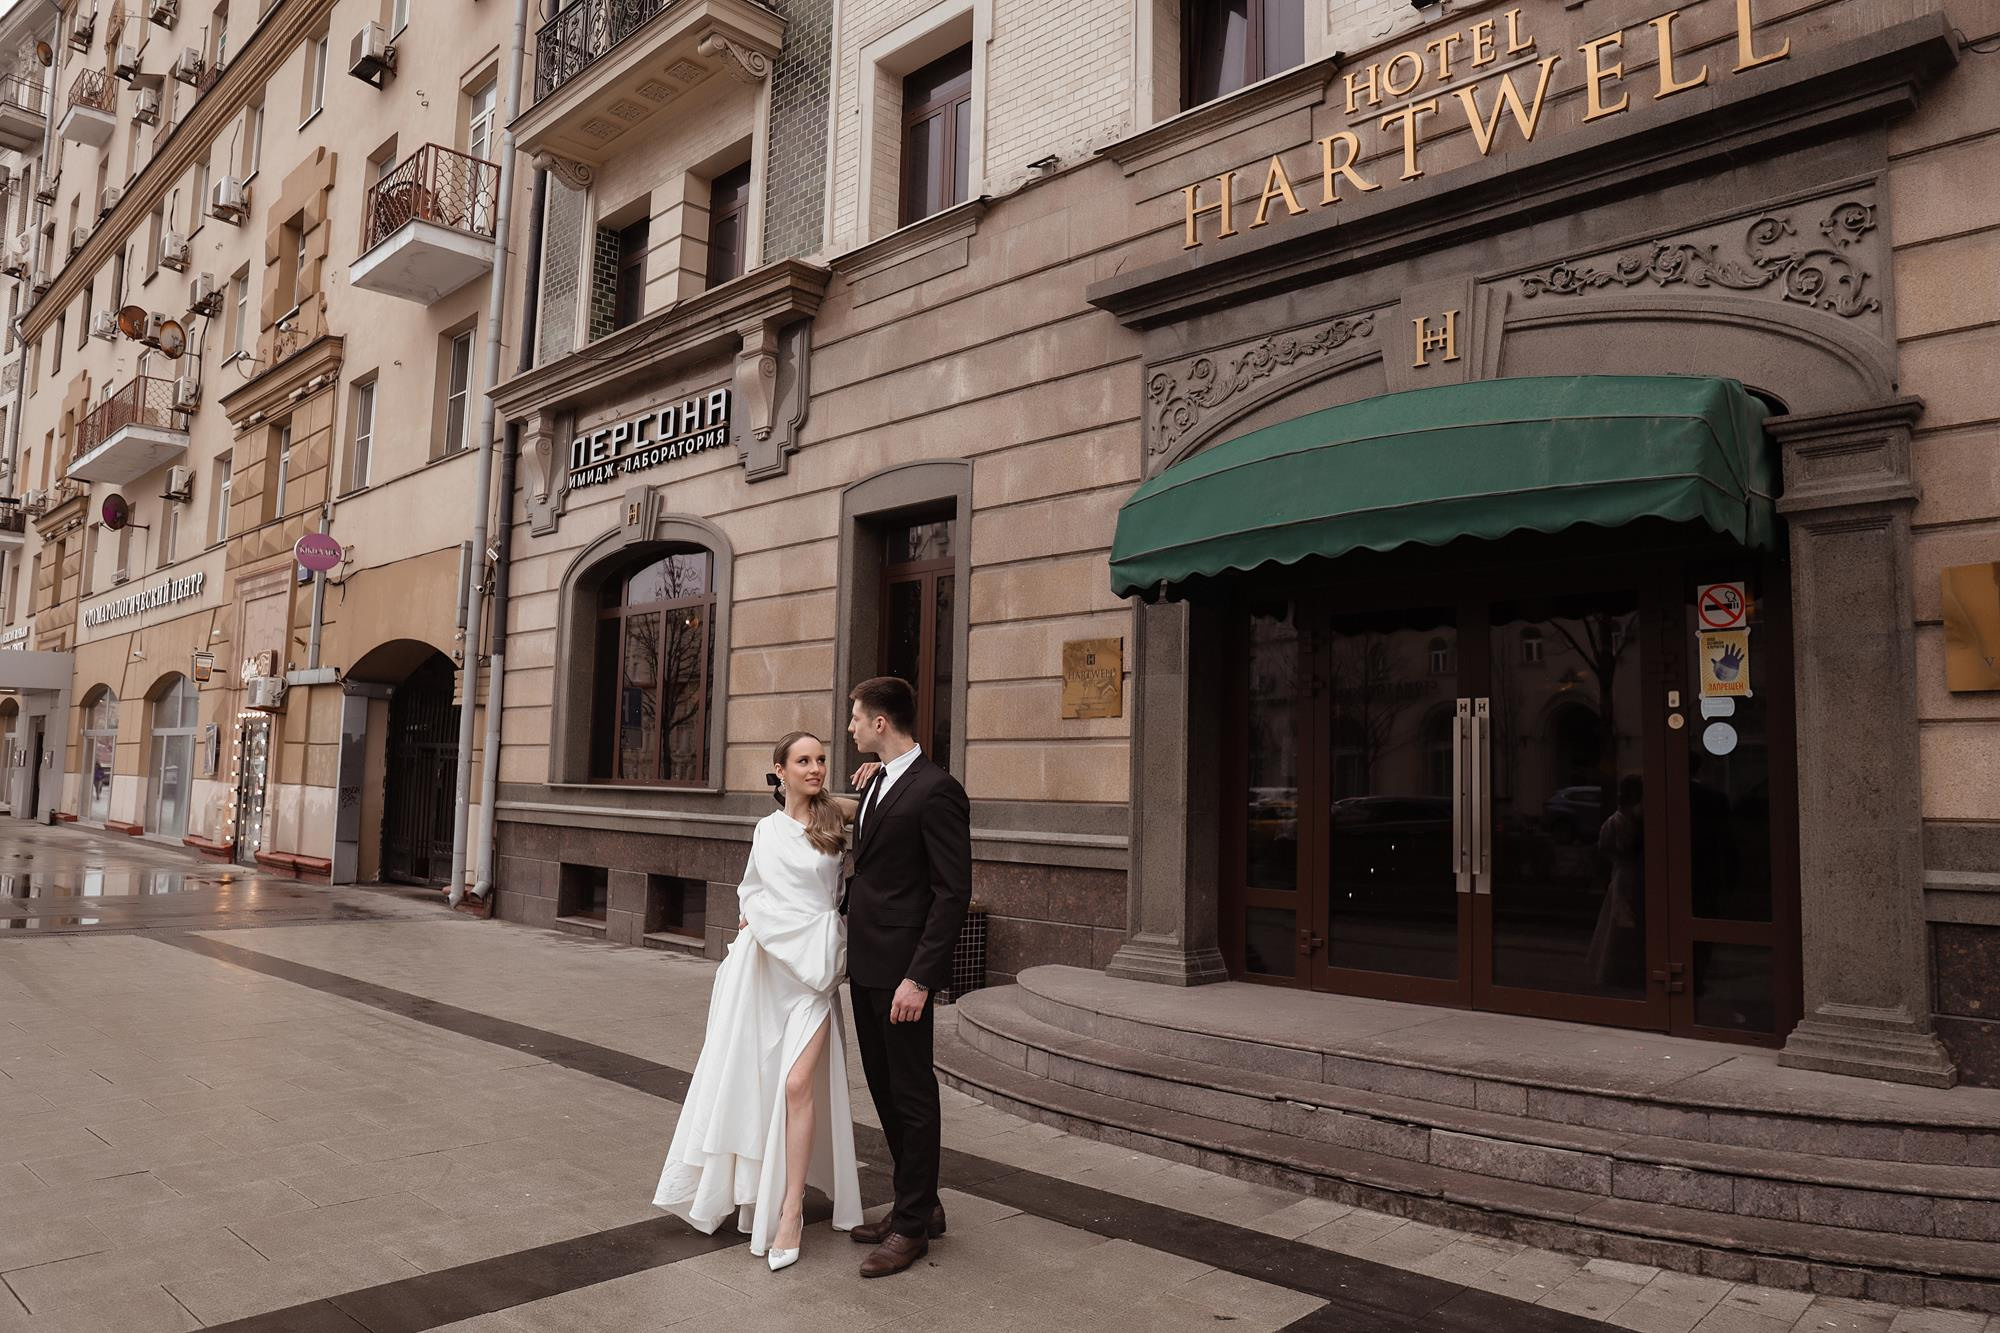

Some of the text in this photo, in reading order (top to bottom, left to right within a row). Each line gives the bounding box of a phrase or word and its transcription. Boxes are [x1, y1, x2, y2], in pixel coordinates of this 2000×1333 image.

[1343, 8, 1536, 114] HOTEL
[1182, 0, 1790, 250] HARTWELL
[570, 388, 730, 469] ПЕРСОНА
[83, 571, 204, 628] СТОМАТОЛОГИЧЕСКИЙ ЦЕНТР
[1708, 682, 1745, 691] ЗАПРЕЩЕН
